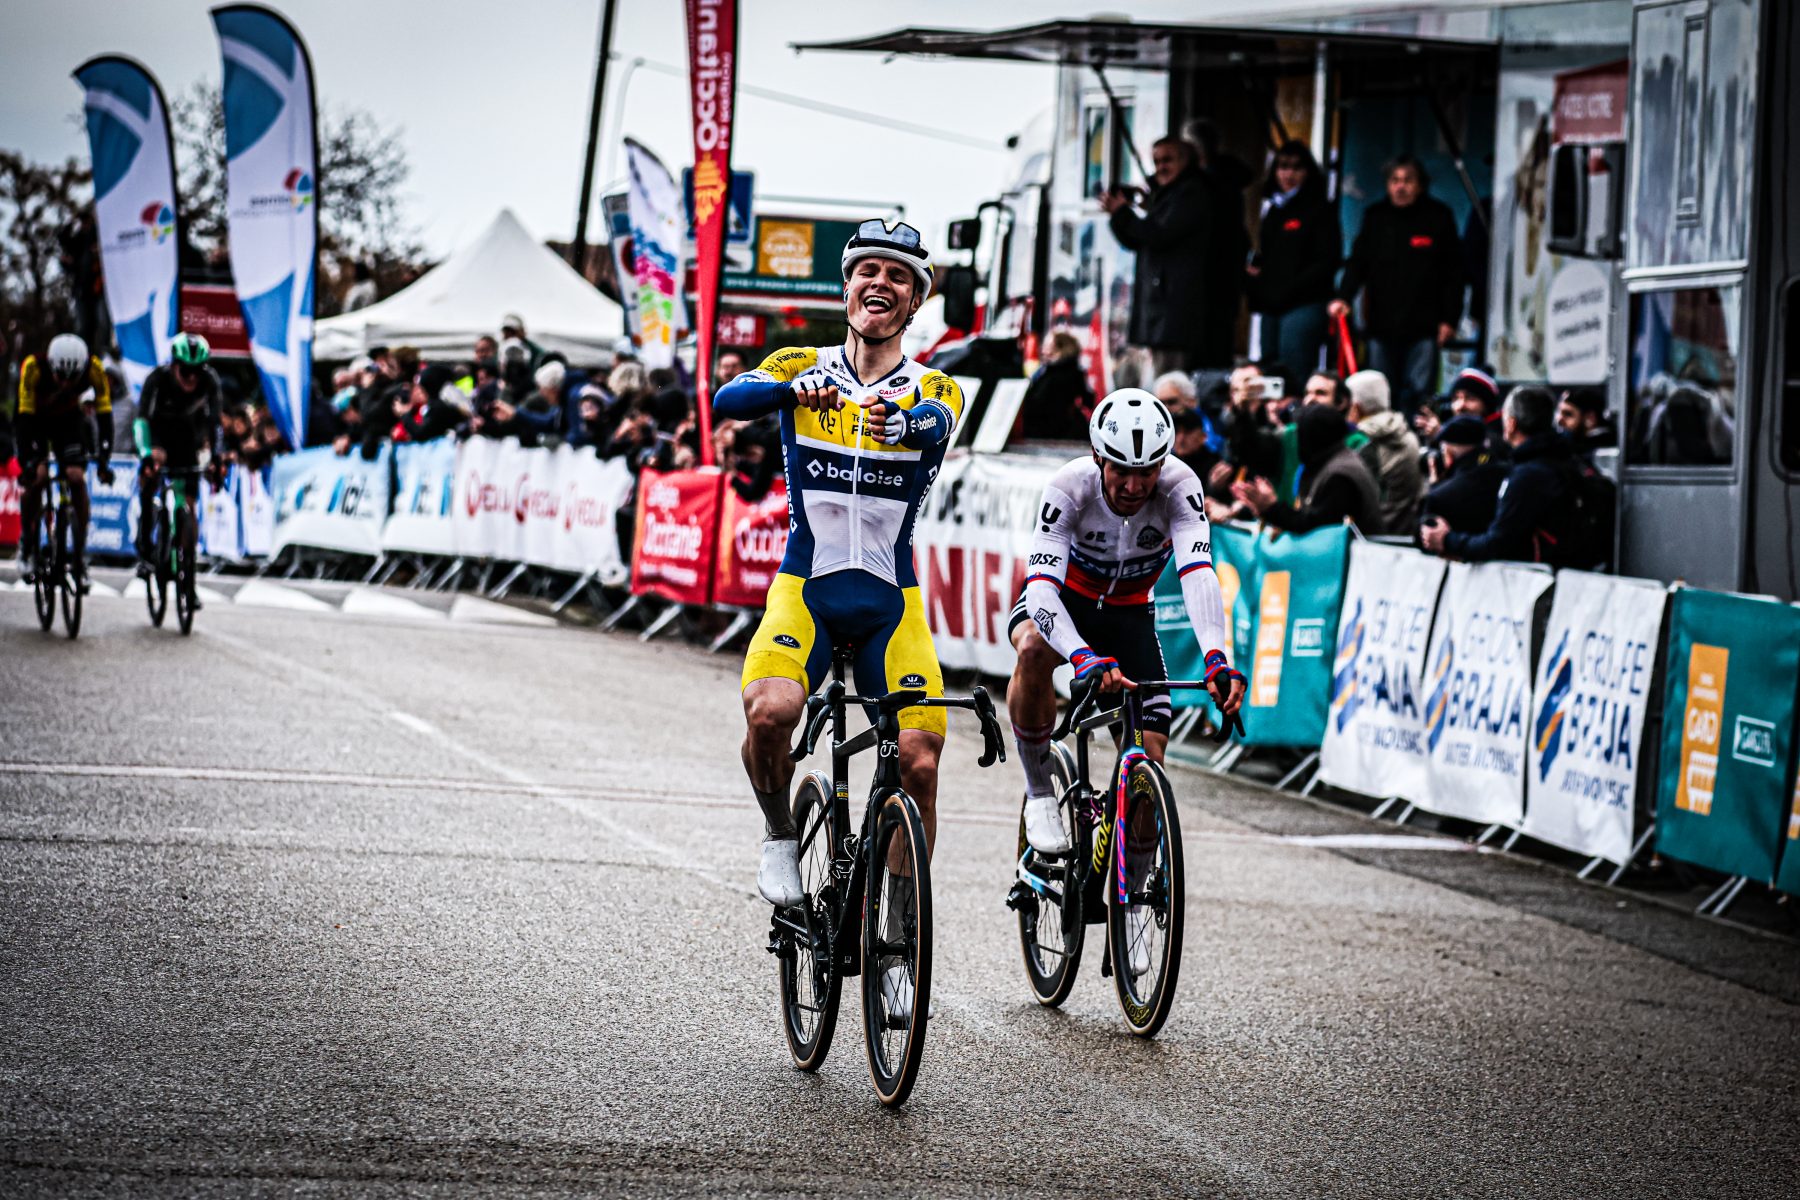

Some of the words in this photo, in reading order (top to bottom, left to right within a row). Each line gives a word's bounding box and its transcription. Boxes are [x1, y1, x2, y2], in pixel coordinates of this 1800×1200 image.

[776, 352, 807, 364] Flanders
[836, 384, 853, 396] oise
[851, 413, 872, 423] Tea
[919, 413, 937, 431] baloise
[850, 425, 872, 437] Fla
[827, 463, 904, 486] baloise
[1192, 541, 1211, 553] RO
